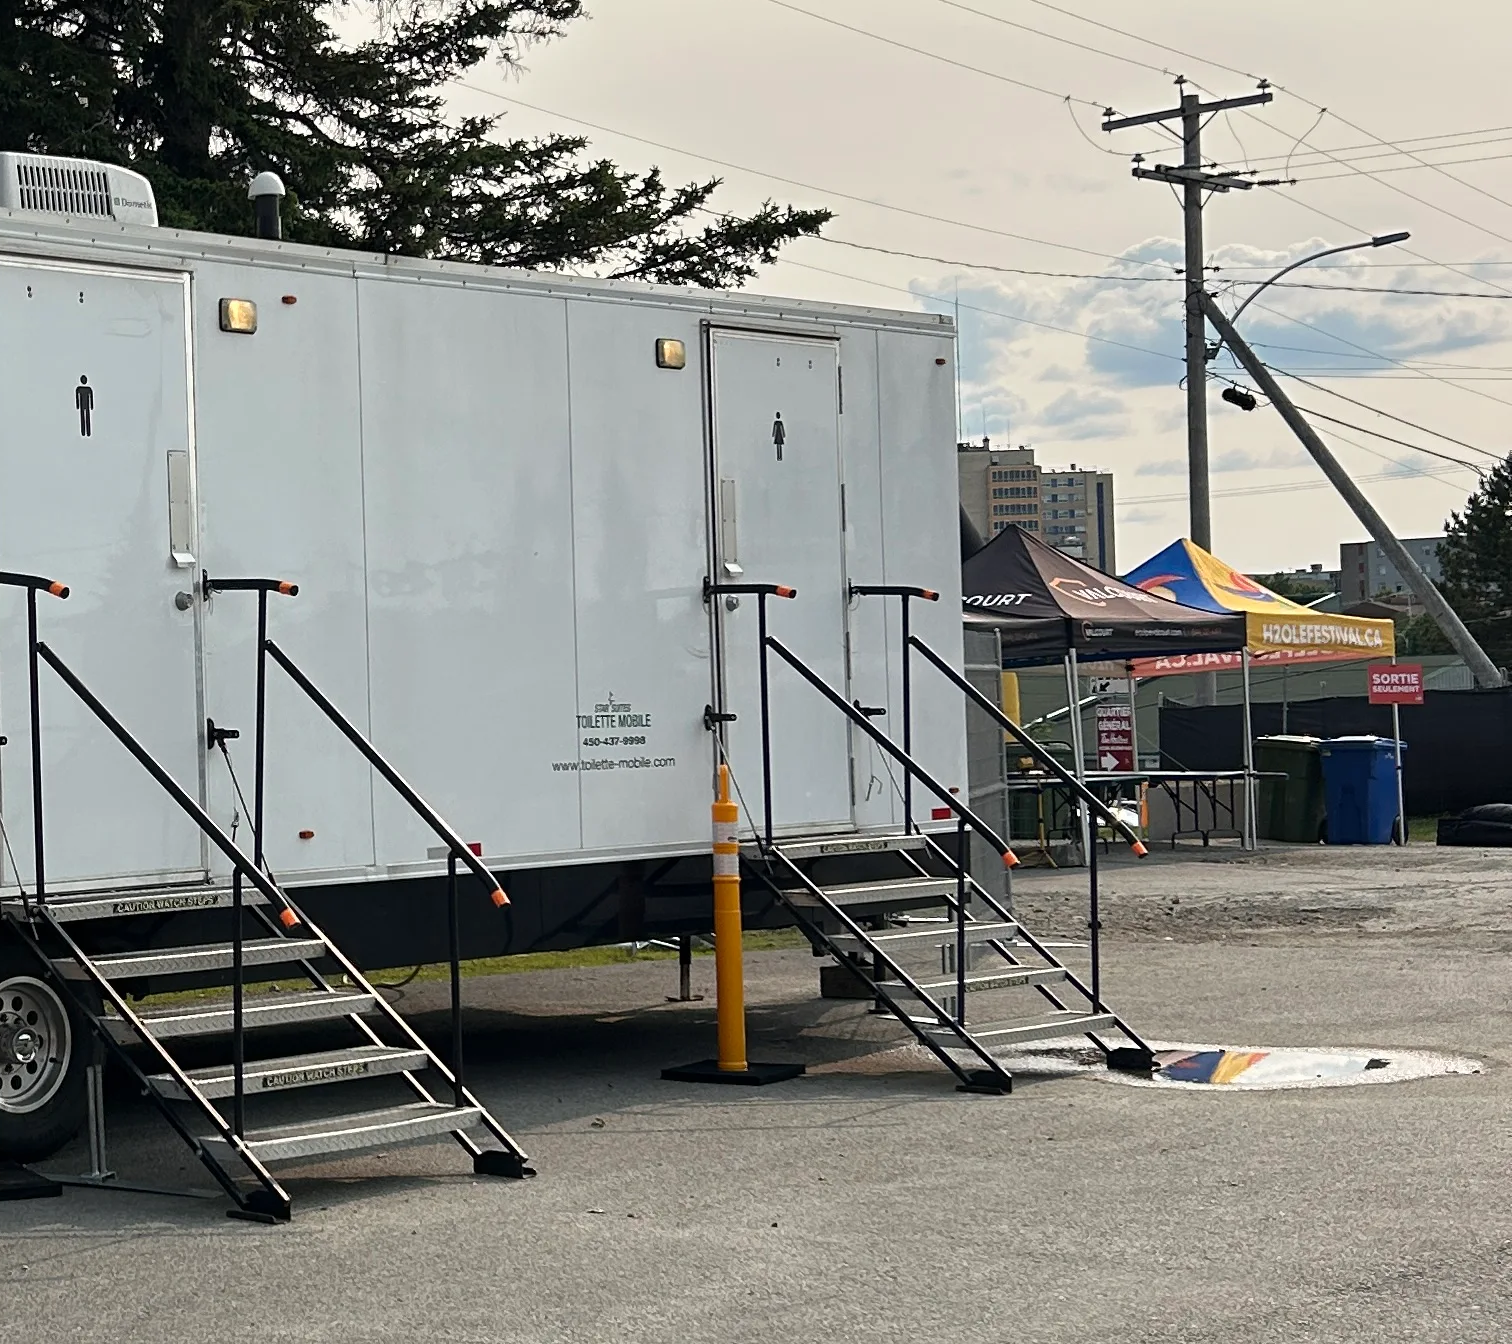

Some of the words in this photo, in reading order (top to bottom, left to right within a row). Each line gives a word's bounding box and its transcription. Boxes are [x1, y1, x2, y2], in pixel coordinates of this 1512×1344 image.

[1372, 673, 1419, 685] SORTIE
[1372, 685, 1420, 693] SEULEMENT
[576, 715, 616, 729] TOILETTE
[618, 713, 651, 728] MOBILE
[552, 757, 676, 771] www.toilette-mobile.com
[117, 901, 155, 913] CAUTION
[156, 898, 187, 909] WATCH
[188, 895, 214, 906] STEPS
[267, 1074, 305, 1087] CAUTION
[306, 1069, 336, 1081] WATCH
[336, 1063, 364, 1076] STEPS
